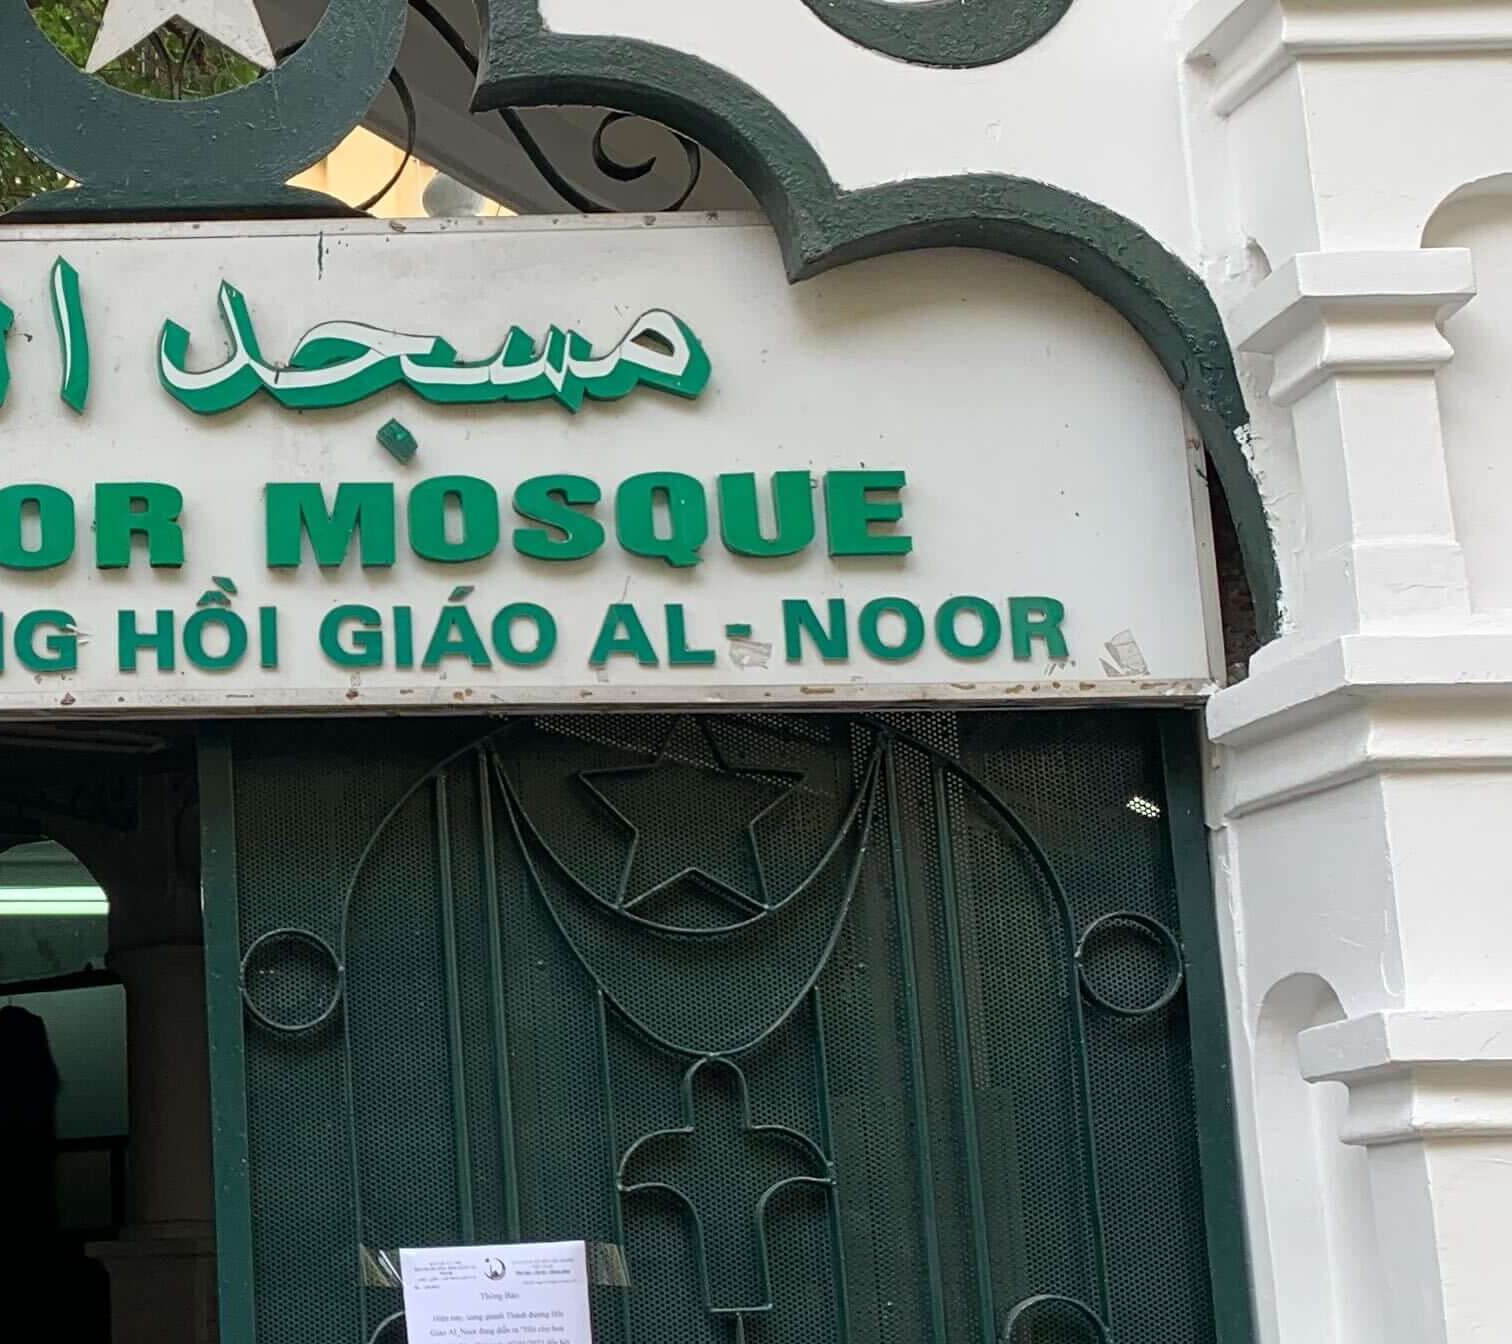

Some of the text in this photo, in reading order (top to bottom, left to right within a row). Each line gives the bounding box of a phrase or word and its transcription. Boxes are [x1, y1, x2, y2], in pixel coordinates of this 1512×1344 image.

[159, 278, 713, 465] مسجد
[265, 470, 914, 569] MOSQUE
[117, 575, 279, 672] HỒI
[318, 585, 558, 669] GIÁO
